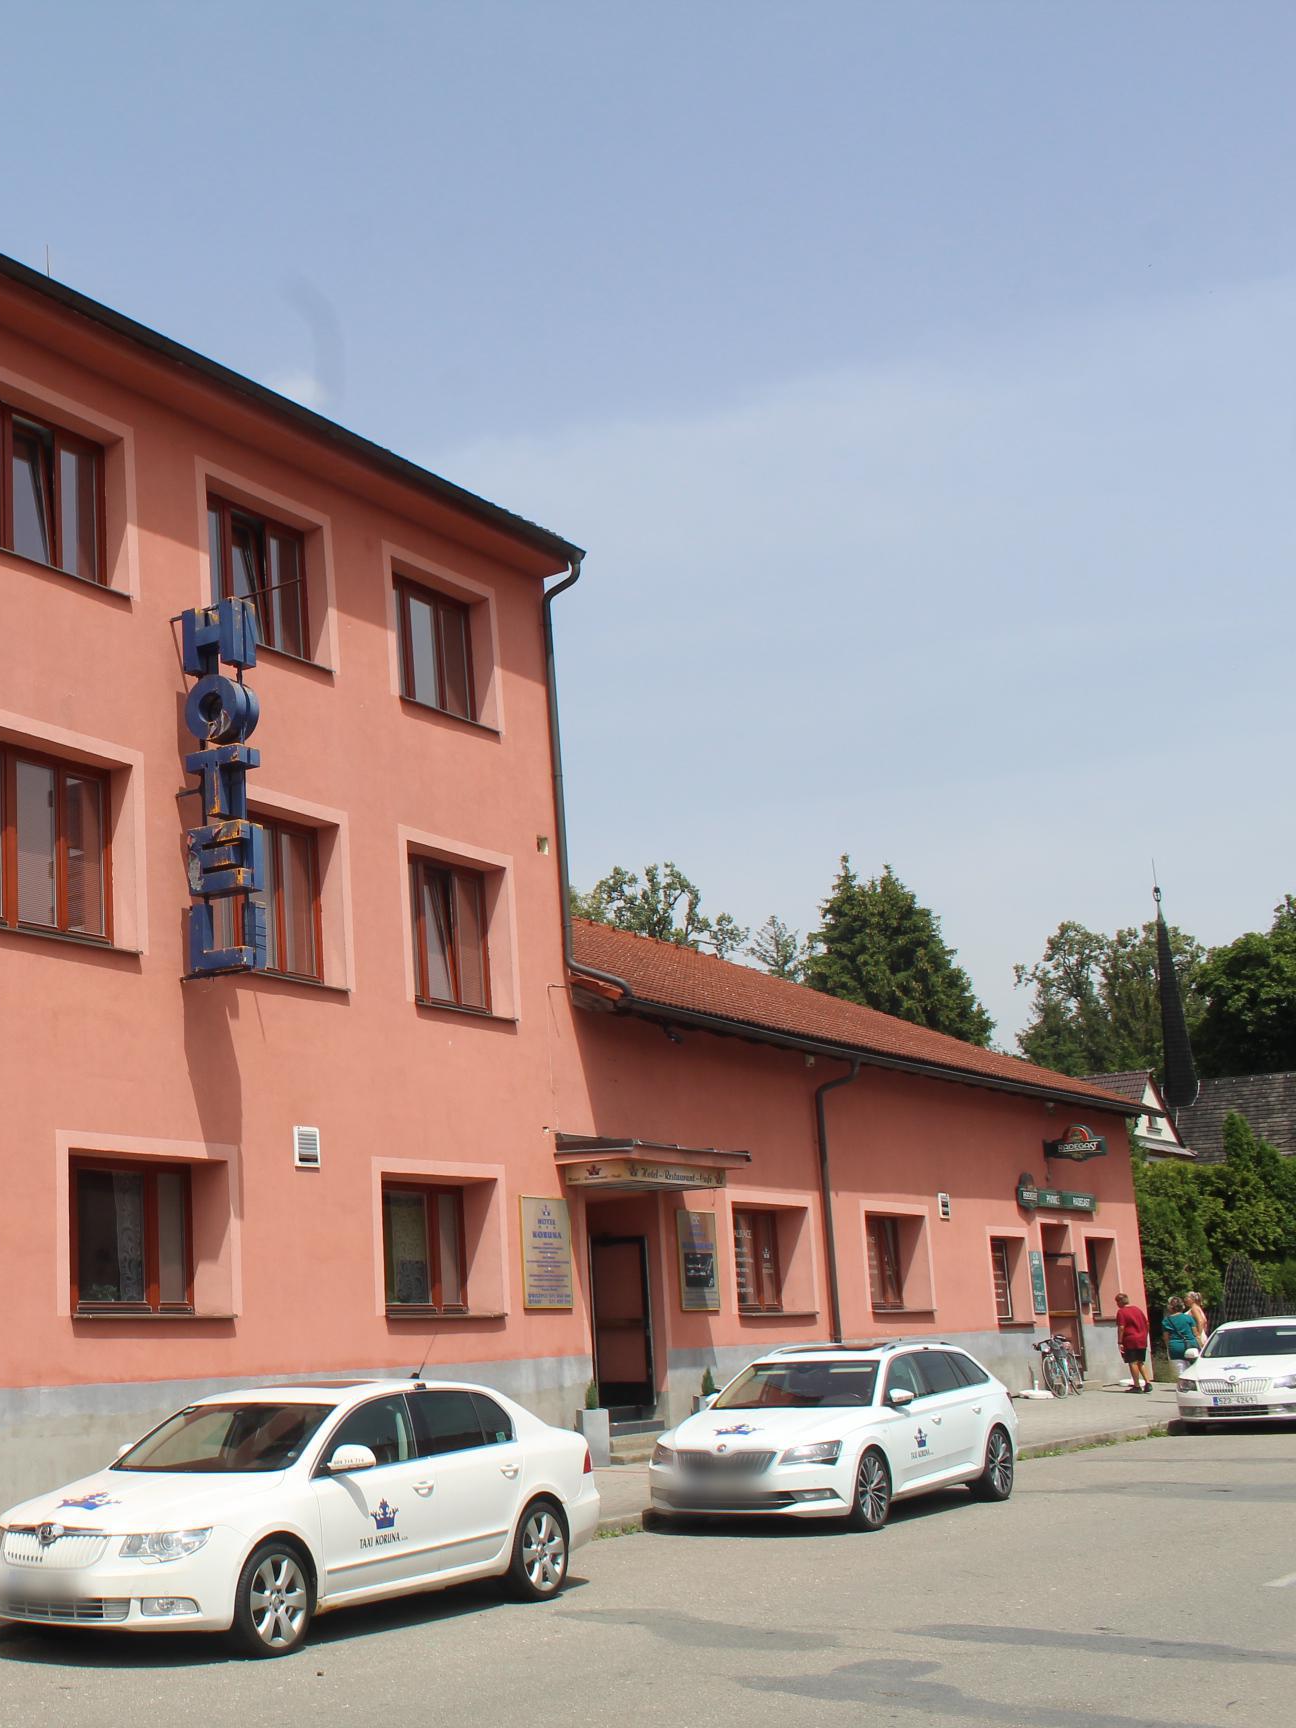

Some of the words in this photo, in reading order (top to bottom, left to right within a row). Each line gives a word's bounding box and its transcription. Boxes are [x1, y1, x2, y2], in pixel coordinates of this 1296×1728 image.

[181, 596, 268, 975] HOTEL
[1057, 1141, 1099, 1152] RADEGAST
[360, 1537, 374, 1549] TAXI
[375, 1532, 400, 1546] KORUNA
